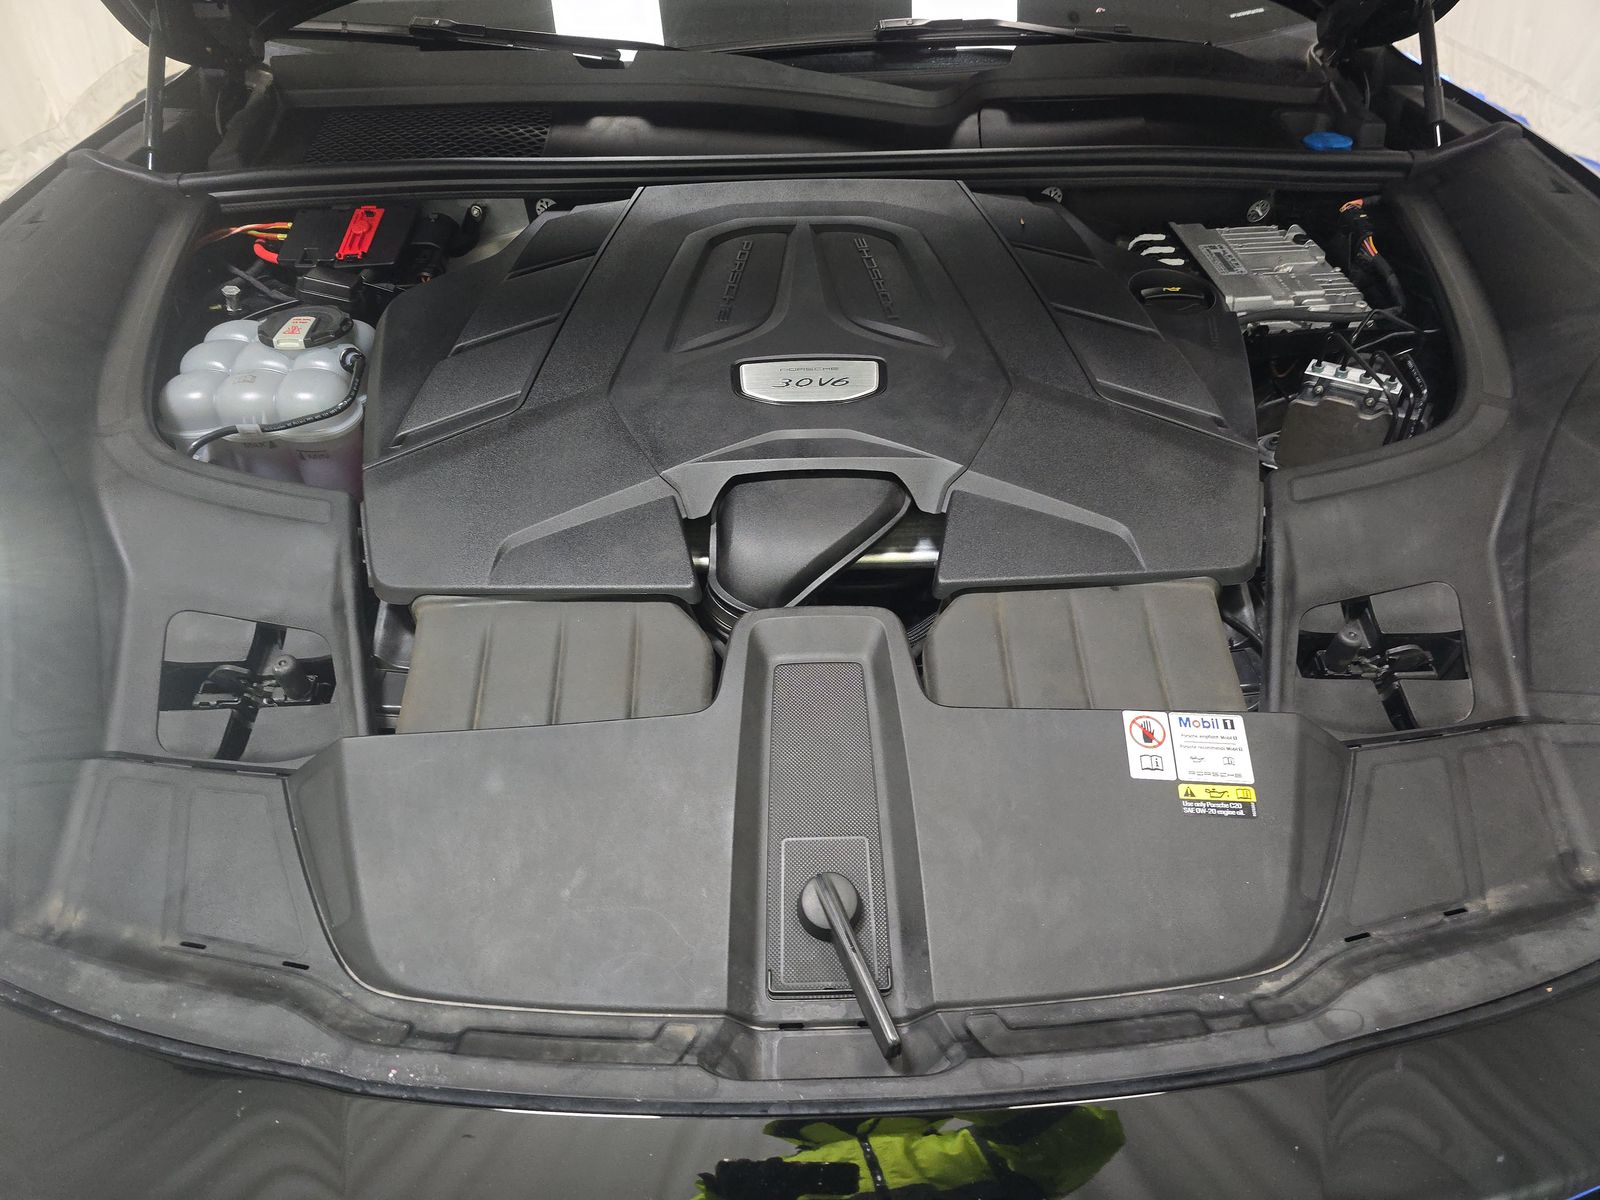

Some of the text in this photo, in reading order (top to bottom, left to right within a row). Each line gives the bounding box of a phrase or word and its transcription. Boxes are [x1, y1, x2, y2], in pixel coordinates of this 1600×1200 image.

[715, 240, 753, 322] PORSCHE
[853, 237, 899, 320] PORSCHE
[819, 377, 849, 387] V6
[1178, 716, 1234, 730] Mobil 1
[1206, 801, 1229, 809] Porsche
